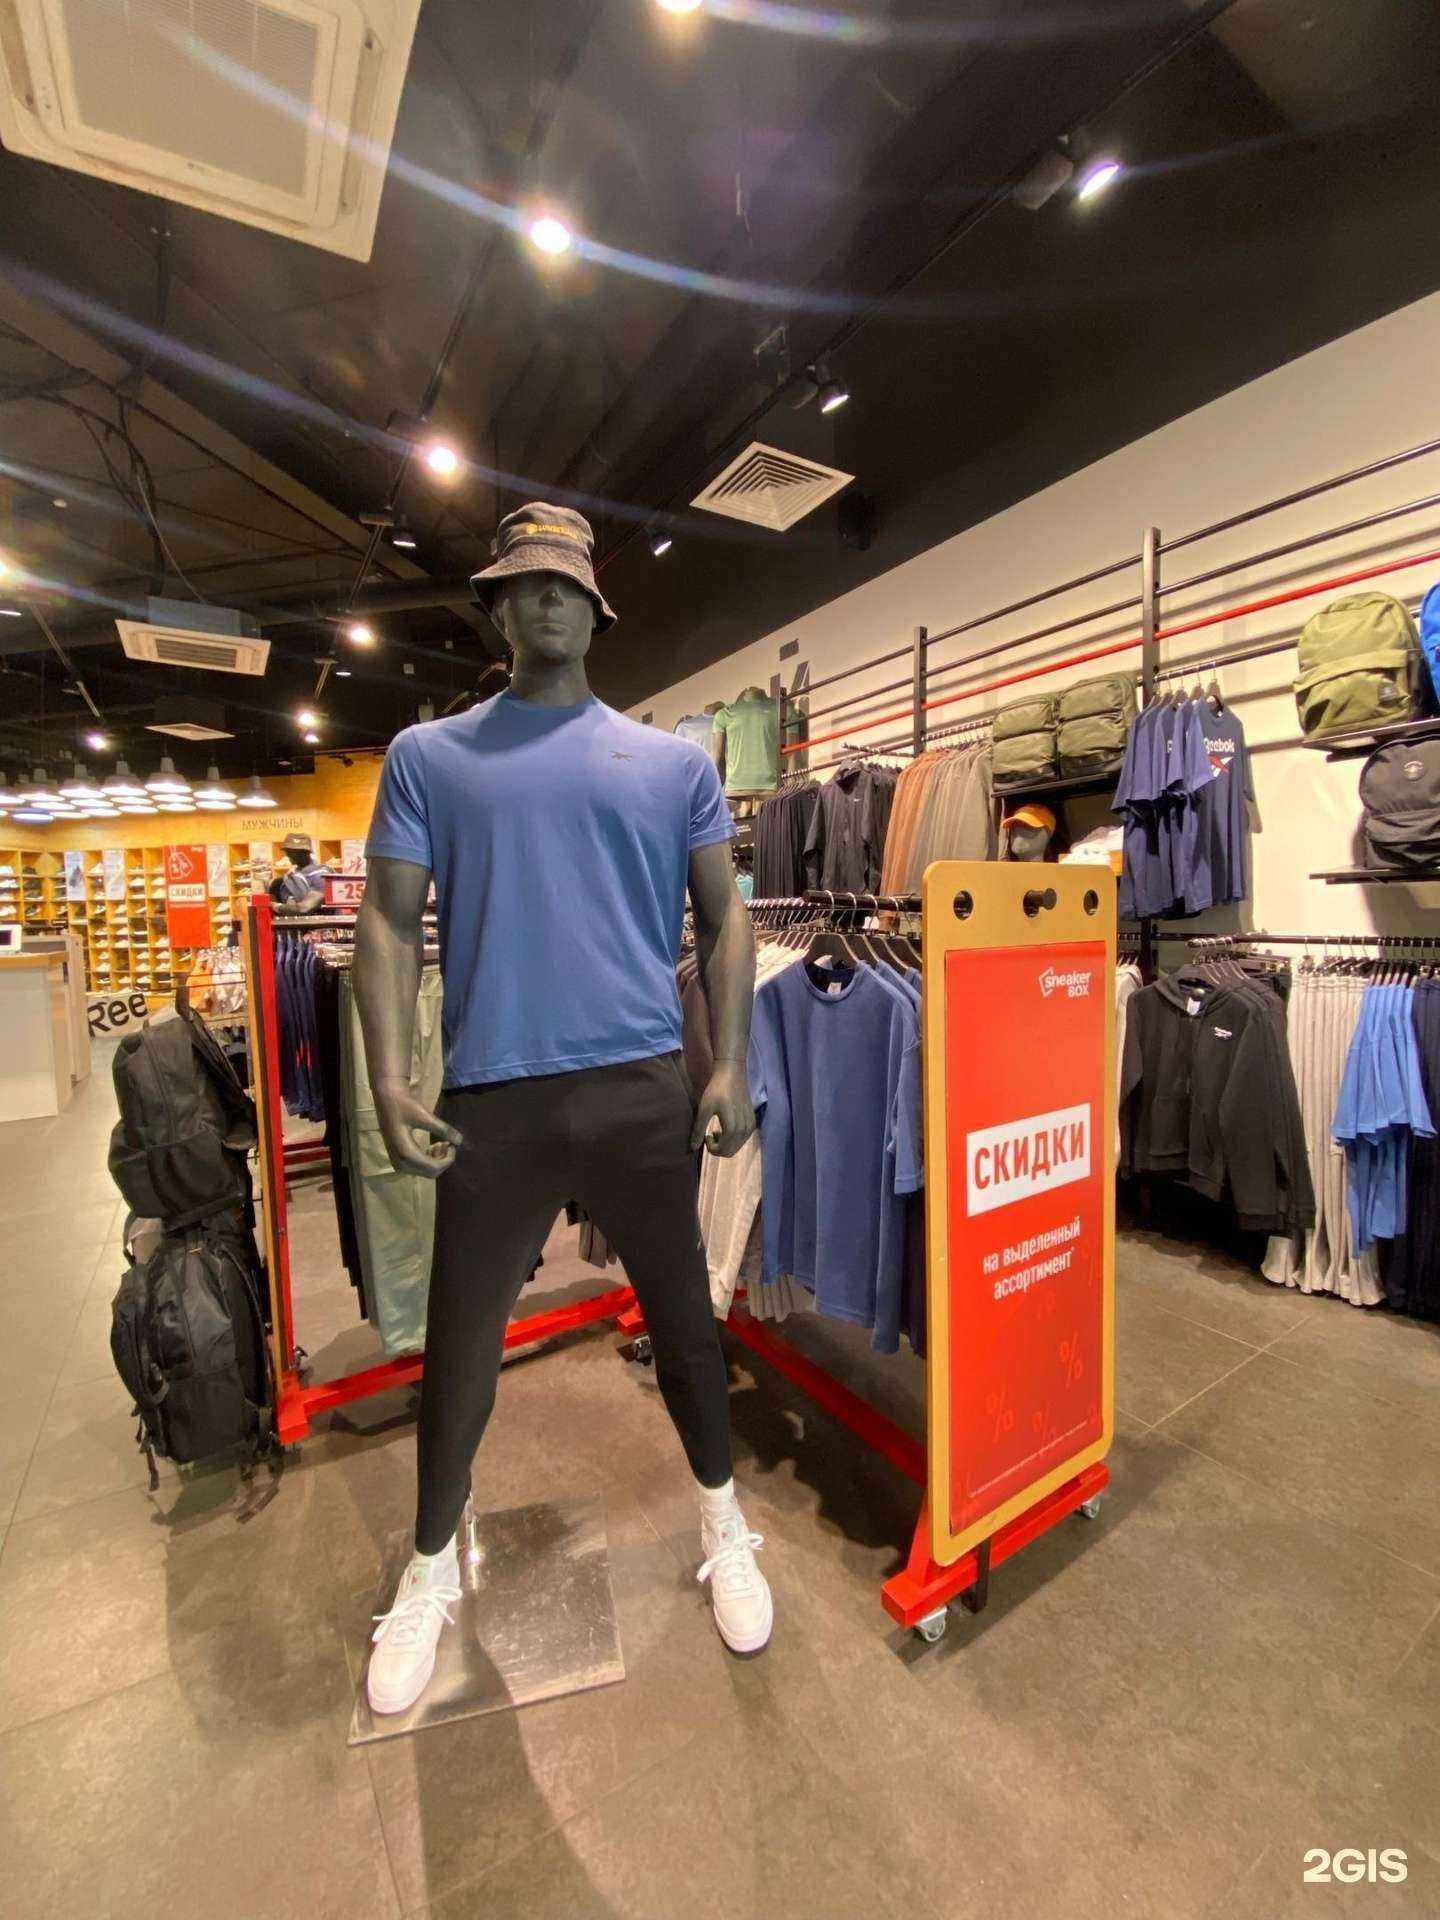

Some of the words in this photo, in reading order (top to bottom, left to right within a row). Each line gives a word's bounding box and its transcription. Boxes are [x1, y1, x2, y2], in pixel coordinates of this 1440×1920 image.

[1044, 971, 1091, 989] sneaker
[974, 1120, 1084, 1190] СКИДКИ
[982, 1252, 999, 1275] на
[1003, 1216, 1080, 1266] выделенный
